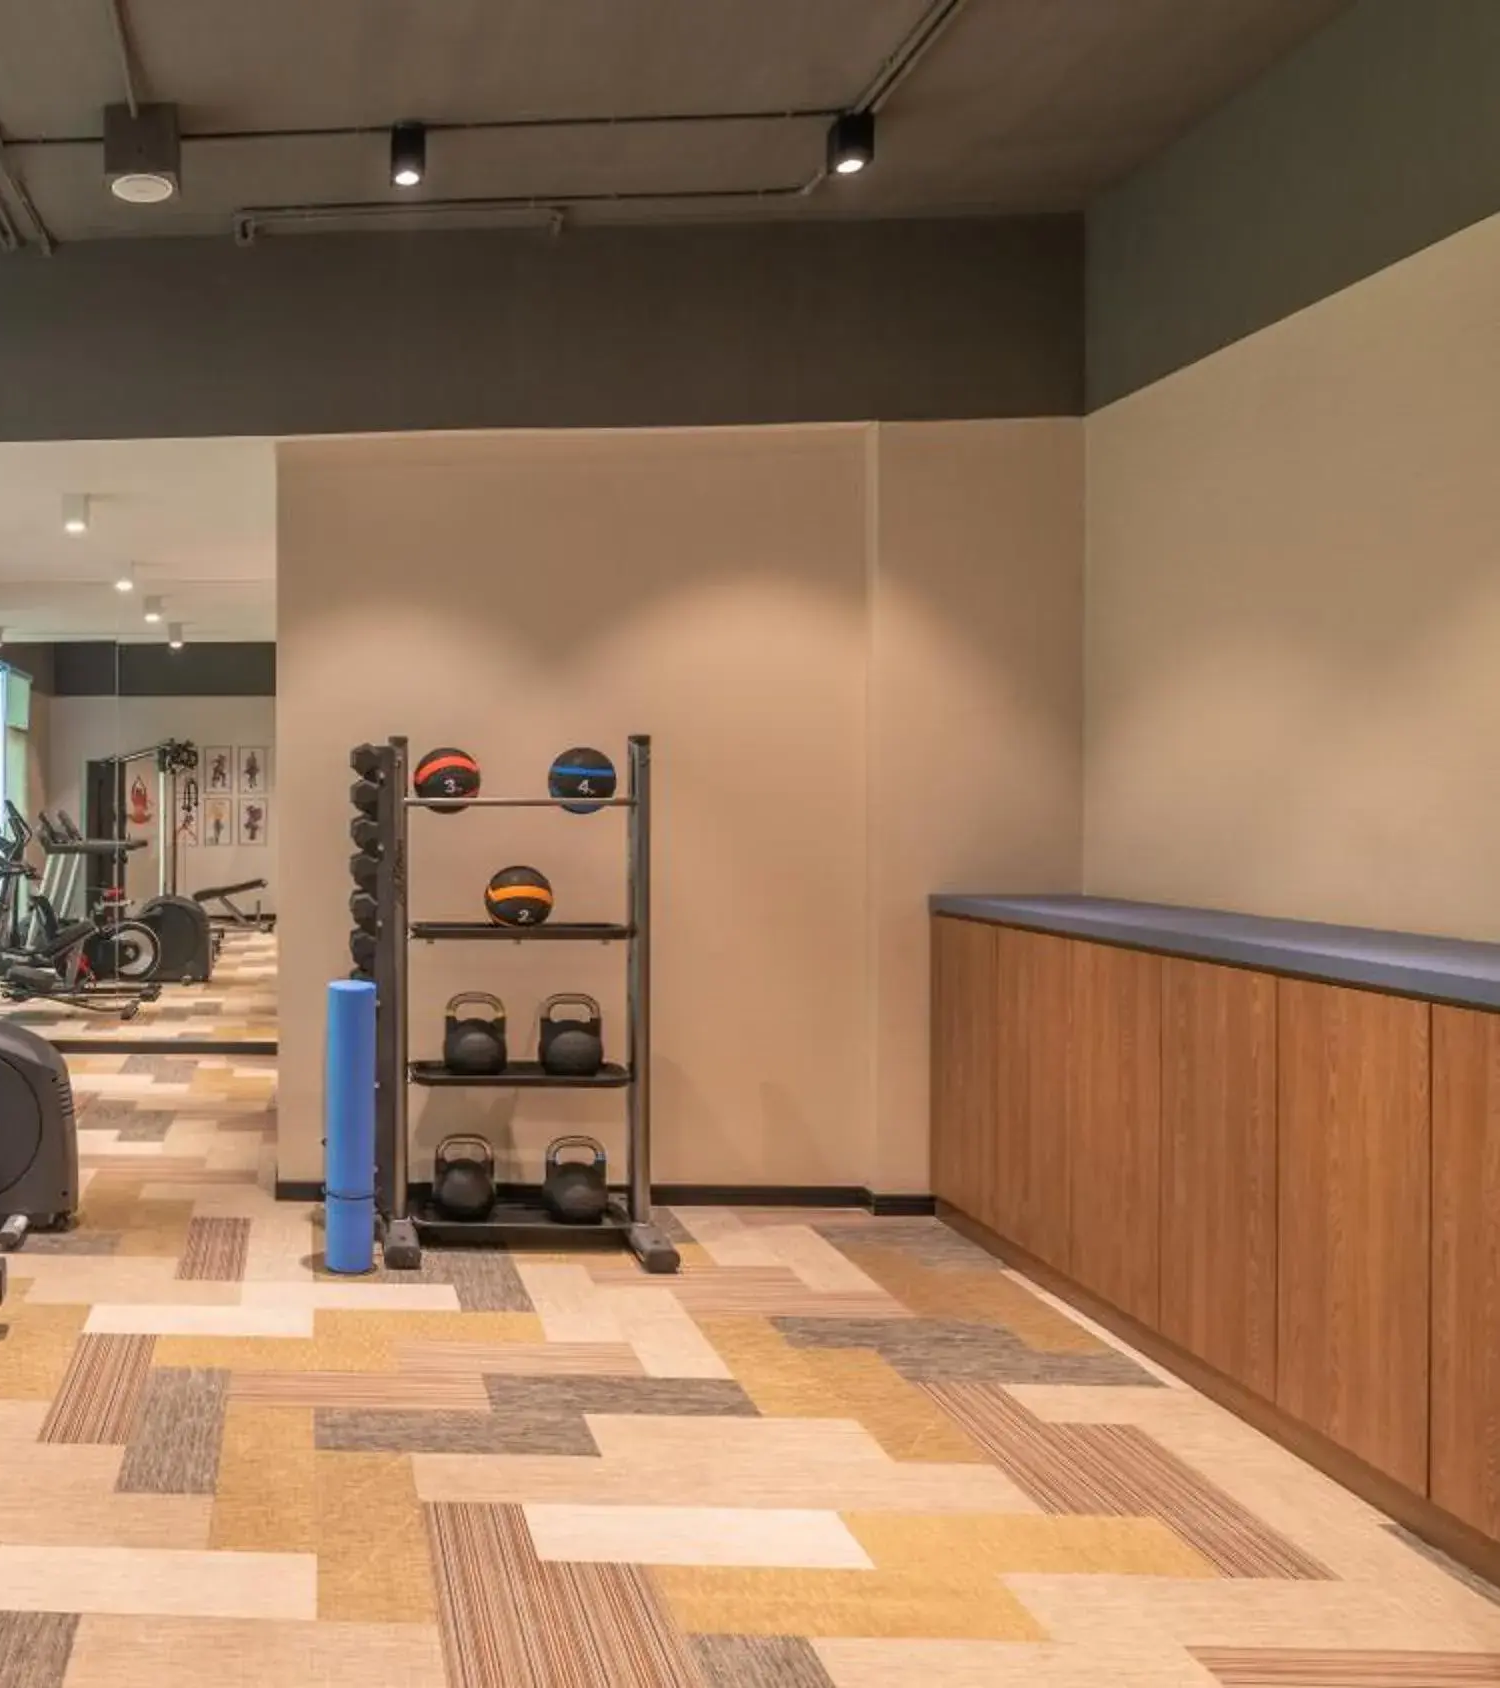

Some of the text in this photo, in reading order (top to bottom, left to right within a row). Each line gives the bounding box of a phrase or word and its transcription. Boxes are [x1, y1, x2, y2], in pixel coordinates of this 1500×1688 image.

[443, 779, 456, 793] 3
[577, 779, 589, 794] 4
[517, 909, 529, 923] 2
